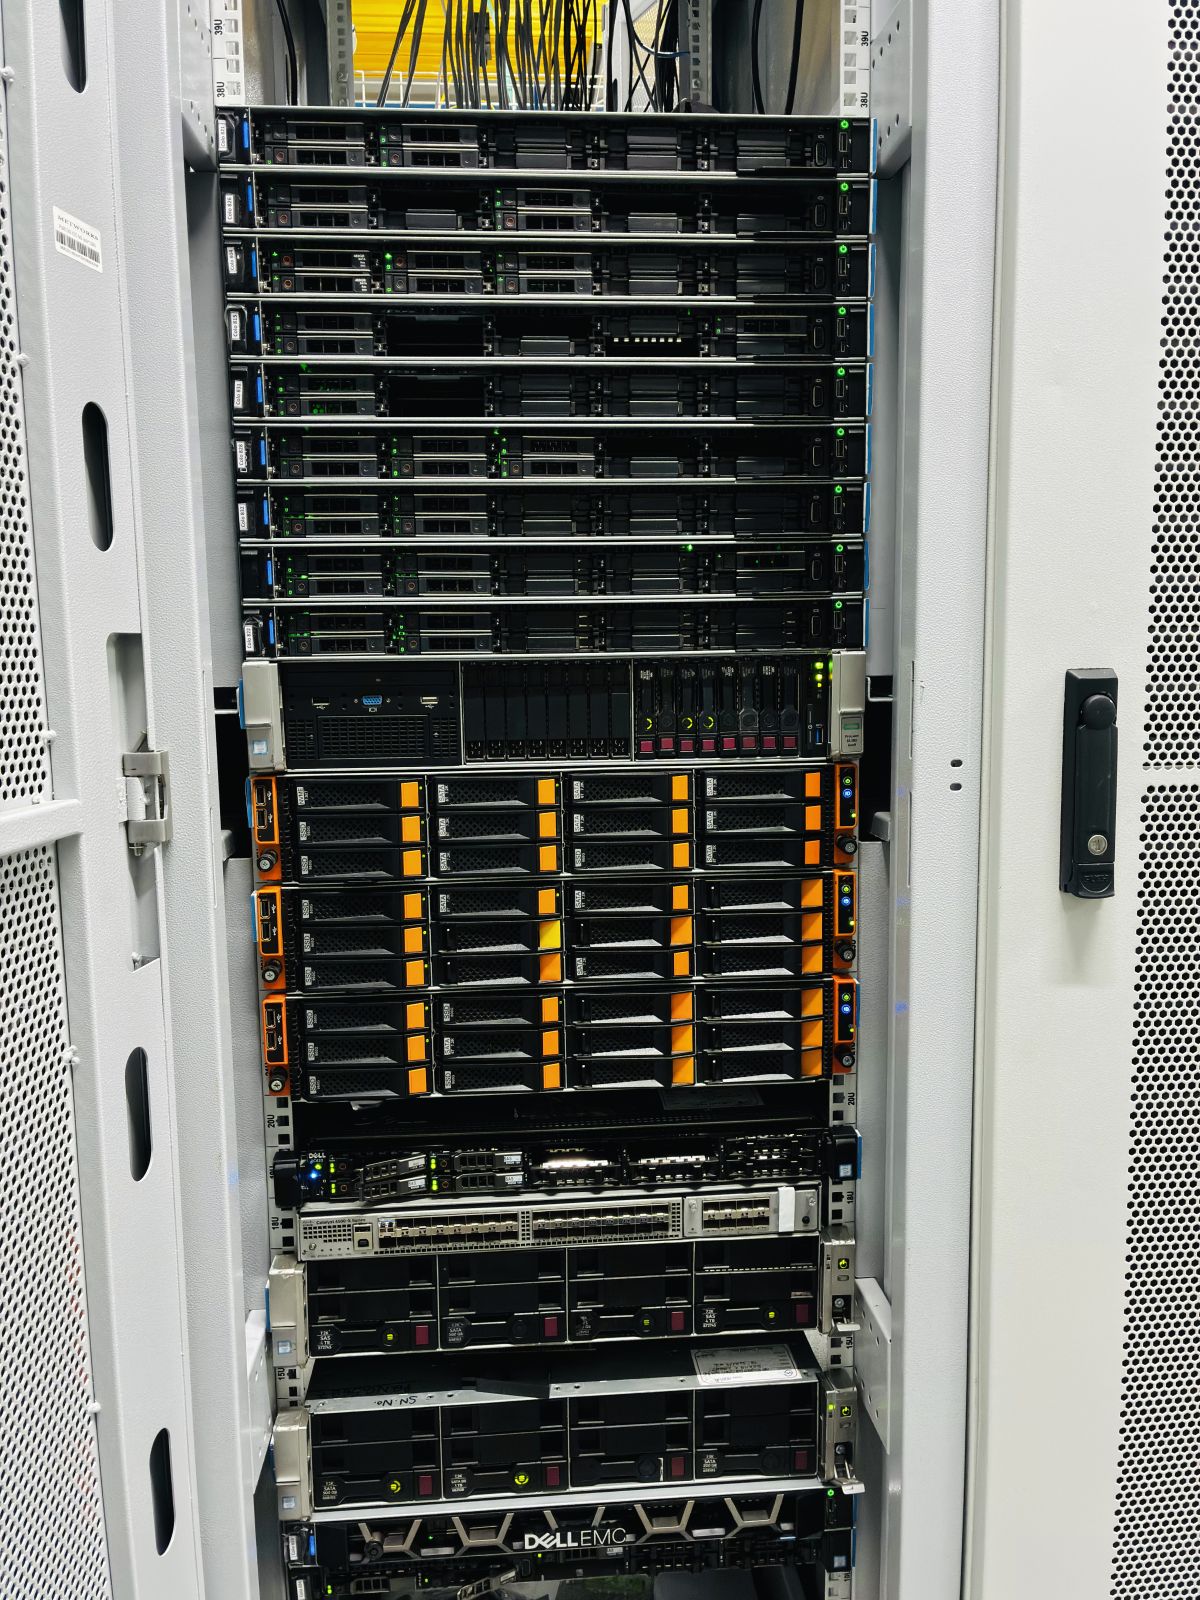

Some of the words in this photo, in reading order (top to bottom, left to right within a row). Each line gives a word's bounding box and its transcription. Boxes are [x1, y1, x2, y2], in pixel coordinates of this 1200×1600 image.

[214, 19, 222, 36] 39U
[216, 82, 225, 98] 38U
[267, 1115, 275, 1128] 20U
[272, 1216, 280, 1230] 18U
[524, 1532, 578, 1549] DELL
[580, 1528, 626, 1546] EMC
